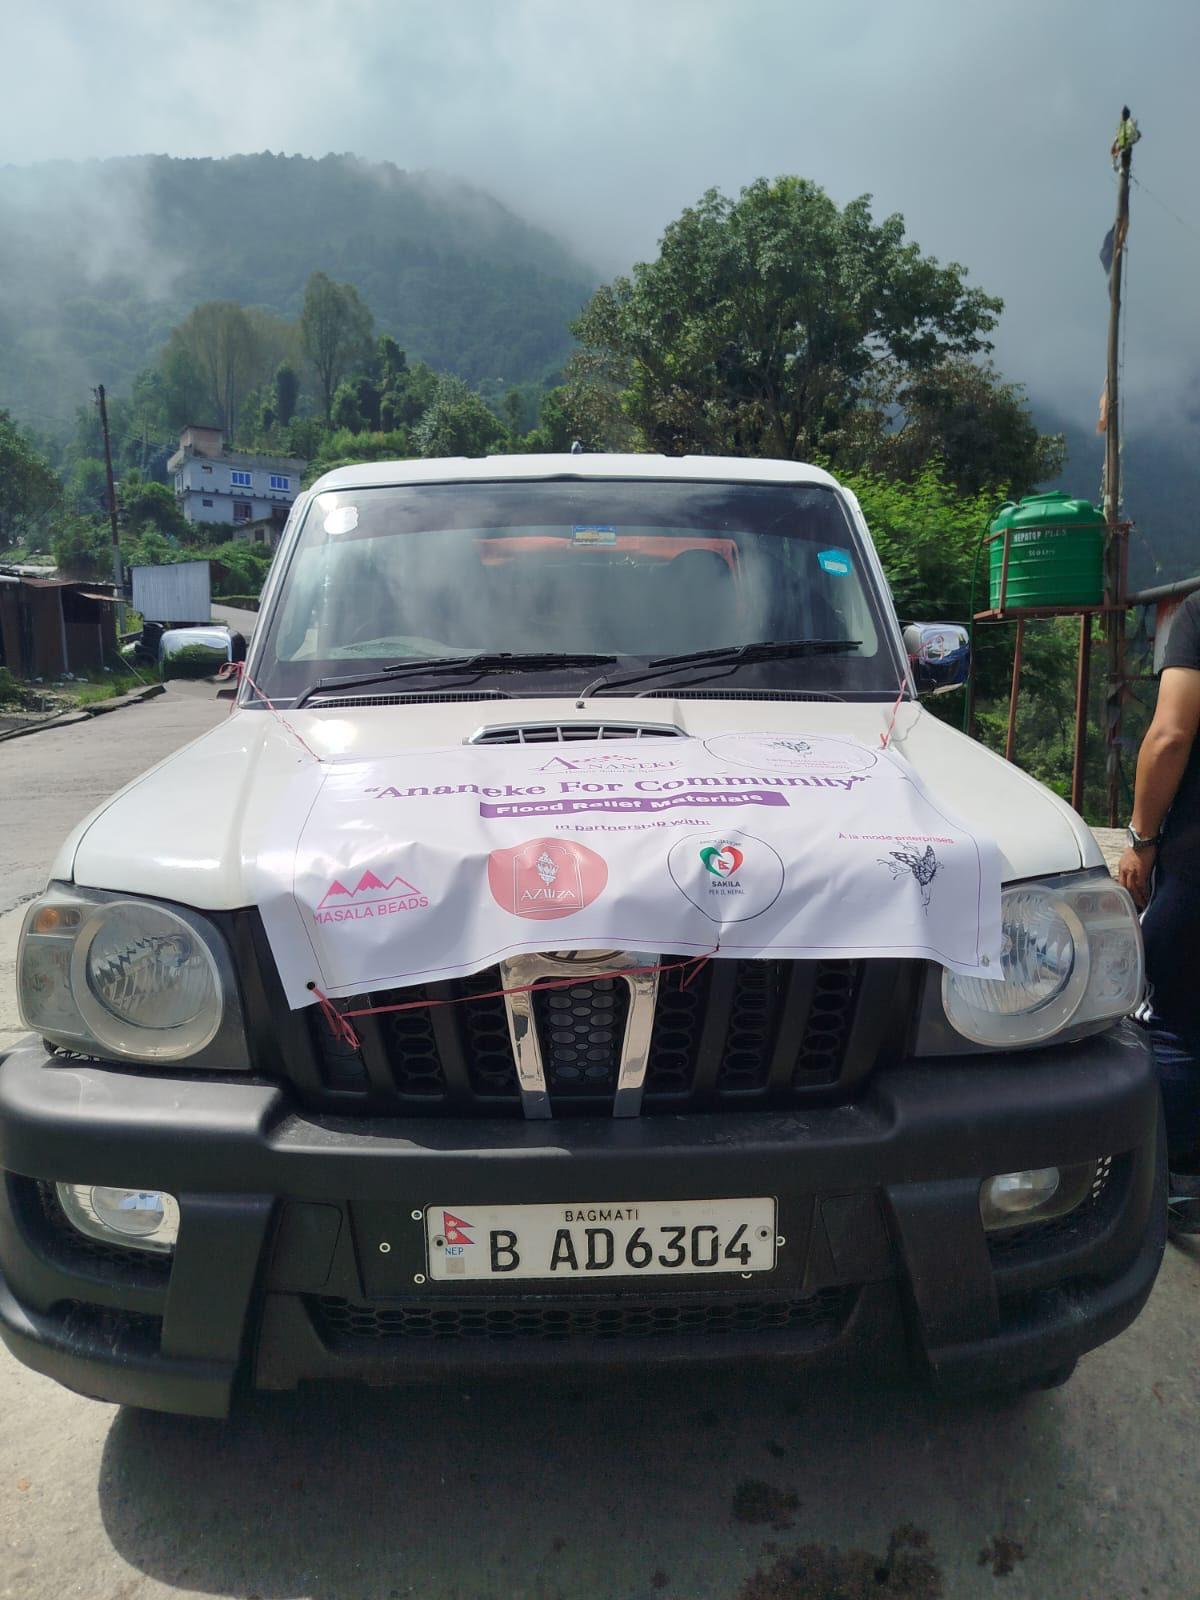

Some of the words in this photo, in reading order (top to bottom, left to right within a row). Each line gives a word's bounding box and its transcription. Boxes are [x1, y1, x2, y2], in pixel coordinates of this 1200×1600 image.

[557, 781, 624, 794] For
[496, 802, 564, 814] Flood
[572, 800, 643, 810] Relief
[651, 793, 764, 809] Materials
[574, 820, 667, 832] partnership
[670, 817, 712, 826] with:
[894, 835, 955, 845] enterprises
[711, 880, 742, 888] SAKILA
[313, 907, 374, 924] MASALA
[378, 896, 429, 914] BEADS
[564, 1208, 639, 1223] BAGMATI
[445, 1246, 464, 1256] NEP
[490, 1230, 520, 1272] B
